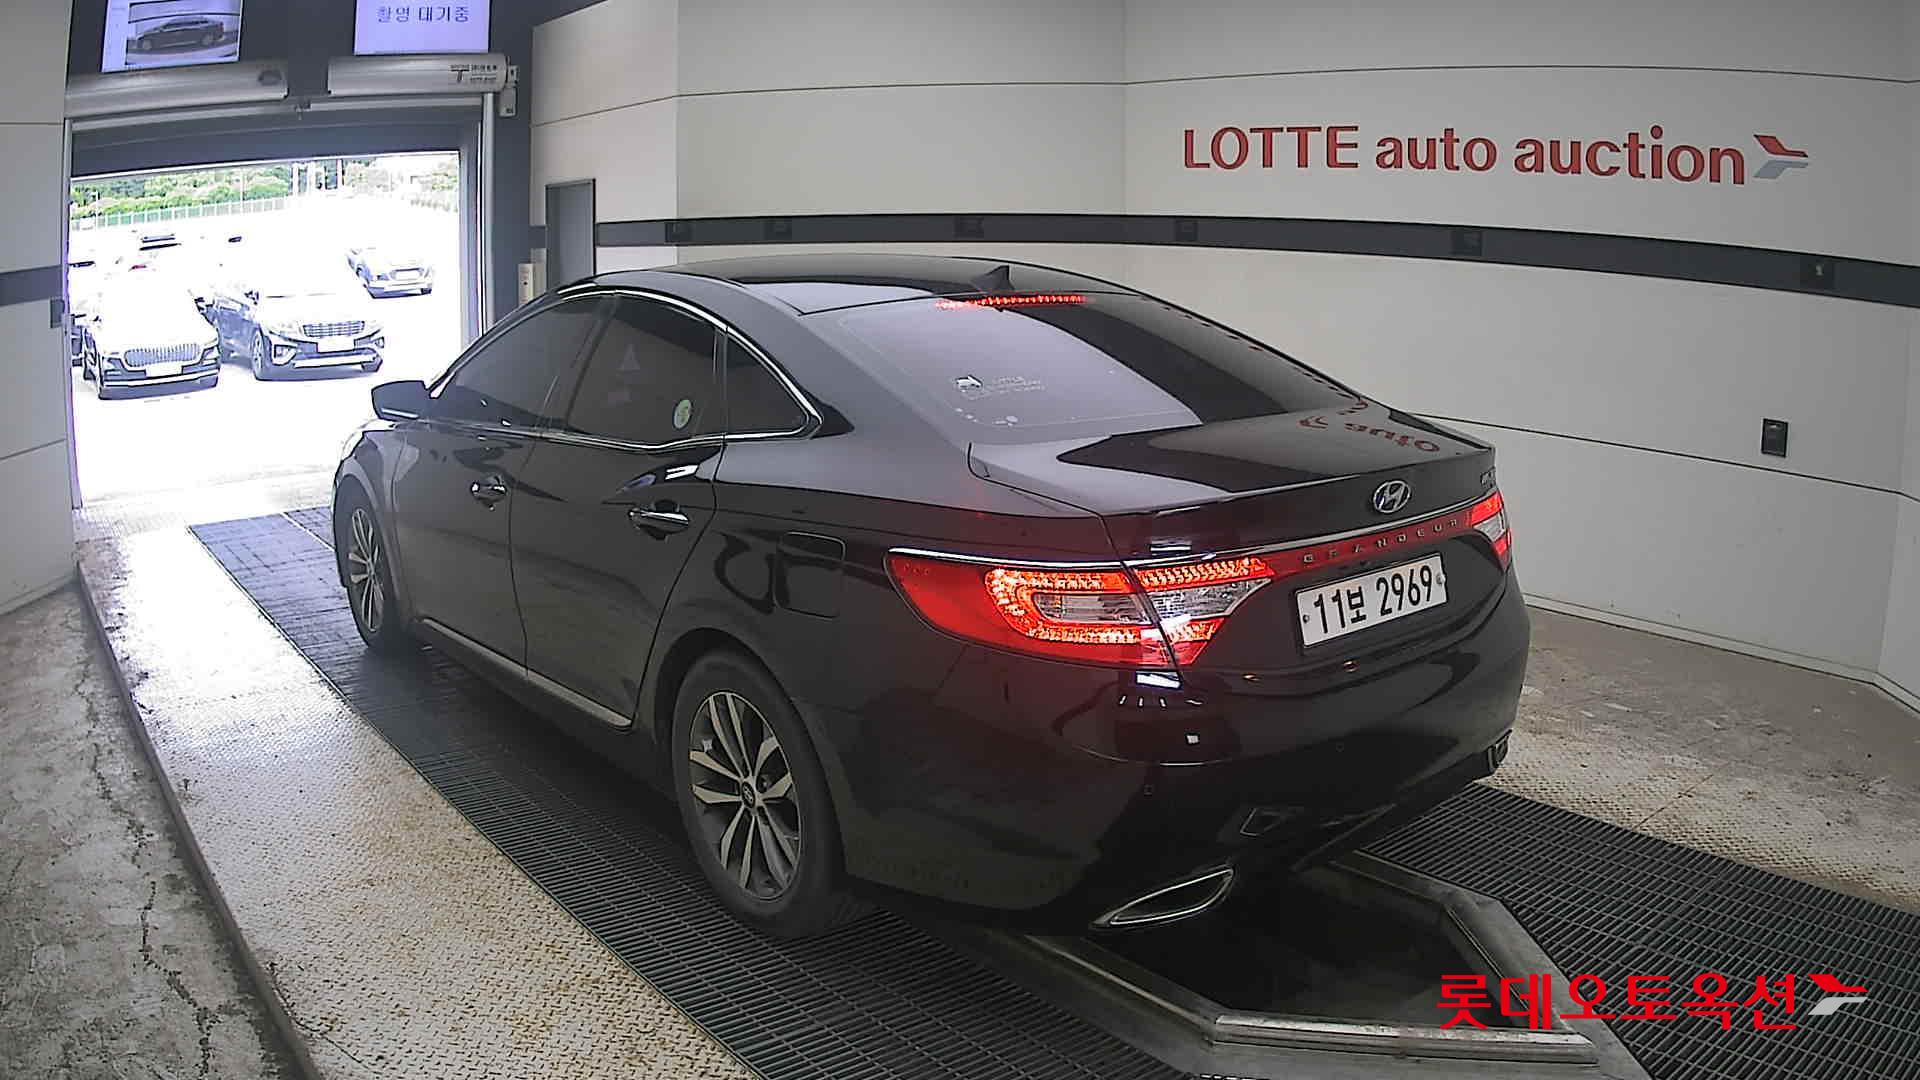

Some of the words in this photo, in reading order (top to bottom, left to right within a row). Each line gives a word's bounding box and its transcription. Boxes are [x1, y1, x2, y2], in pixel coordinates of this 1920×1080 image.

[418, 6, 469, 23] 대기중
[1184, 126, 1359, 169] LOTTE
[1375, 128, 1498, 171] auto
[1513, 125, 1745, 185] auction
[1313, 586, 1367, 634] 11보
[1376, 565, 1433, 617] 2969
